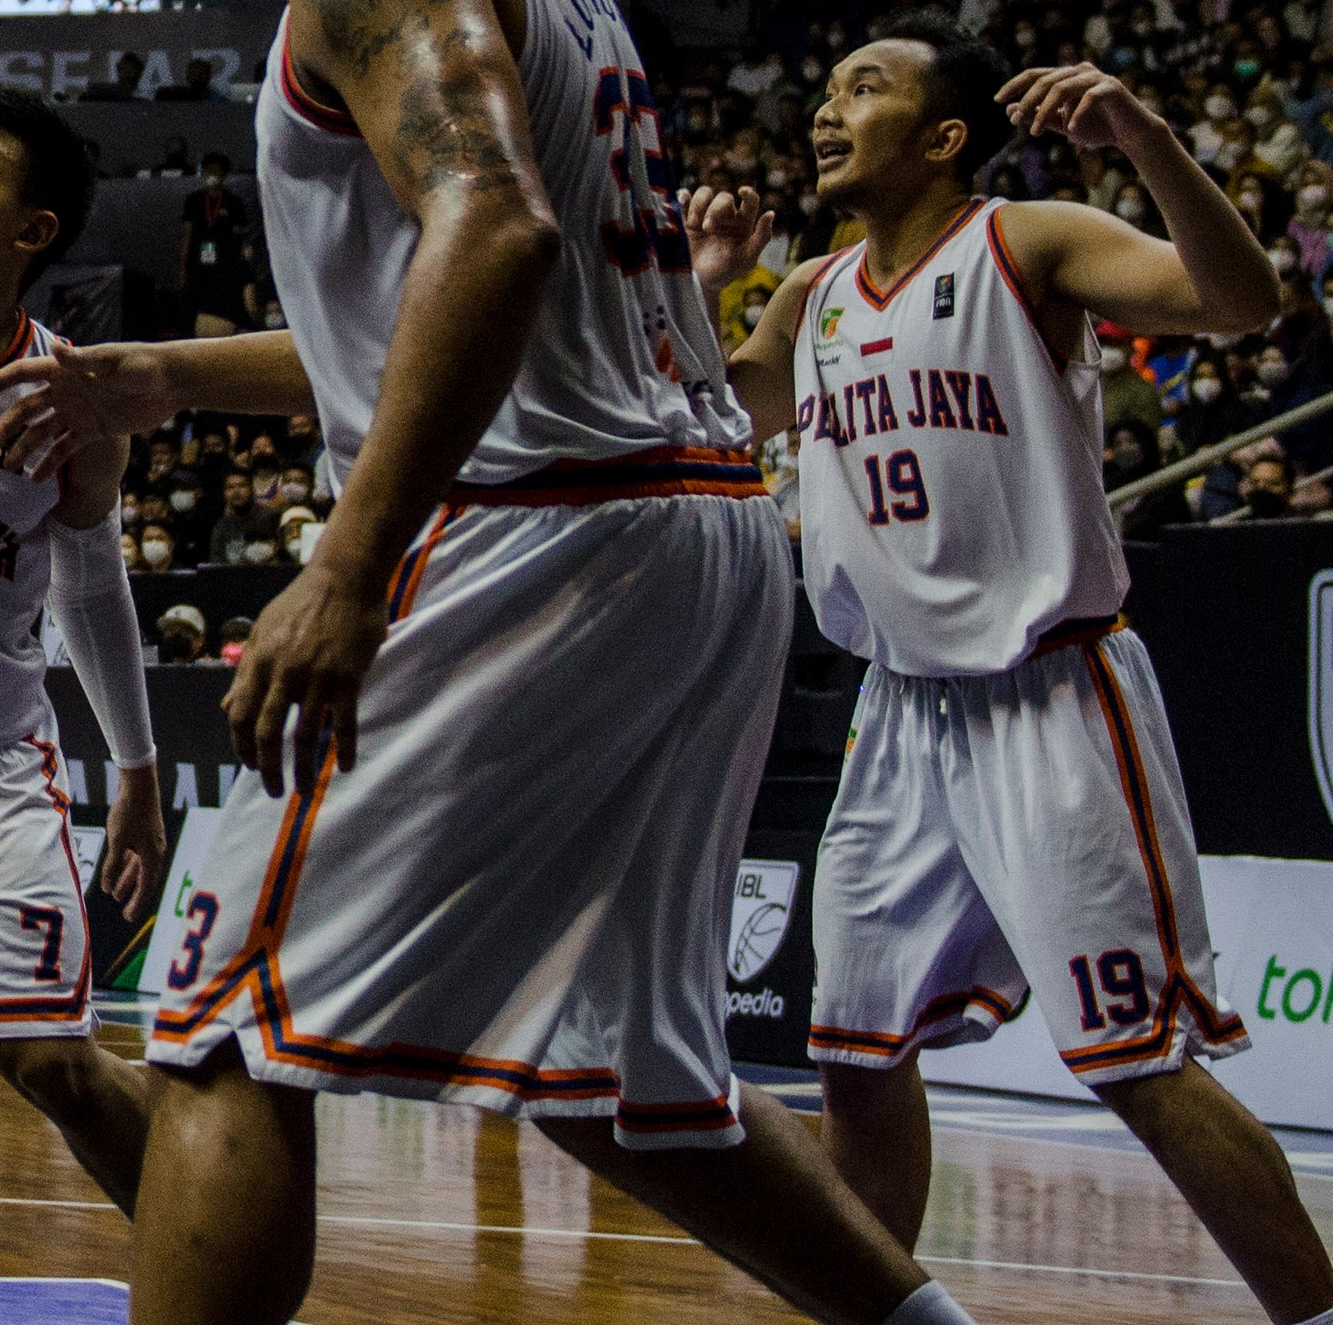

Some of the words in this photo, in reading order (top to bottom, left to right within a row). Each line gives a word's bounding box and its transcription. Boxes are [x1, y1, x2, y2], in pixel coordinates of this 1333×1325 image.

[596, 66, 692, 276] 33
[797, 374, 899, 447] PELITA
[907, 370, 1009, 436] JAYA
[864, 449, 929, 524] 19
[737, 874, 766, 899] IBL
[20, 906, 63, 984] 7
[168, 890, 219, 990] 3
[1069, 949, 1150, 1033] 19
